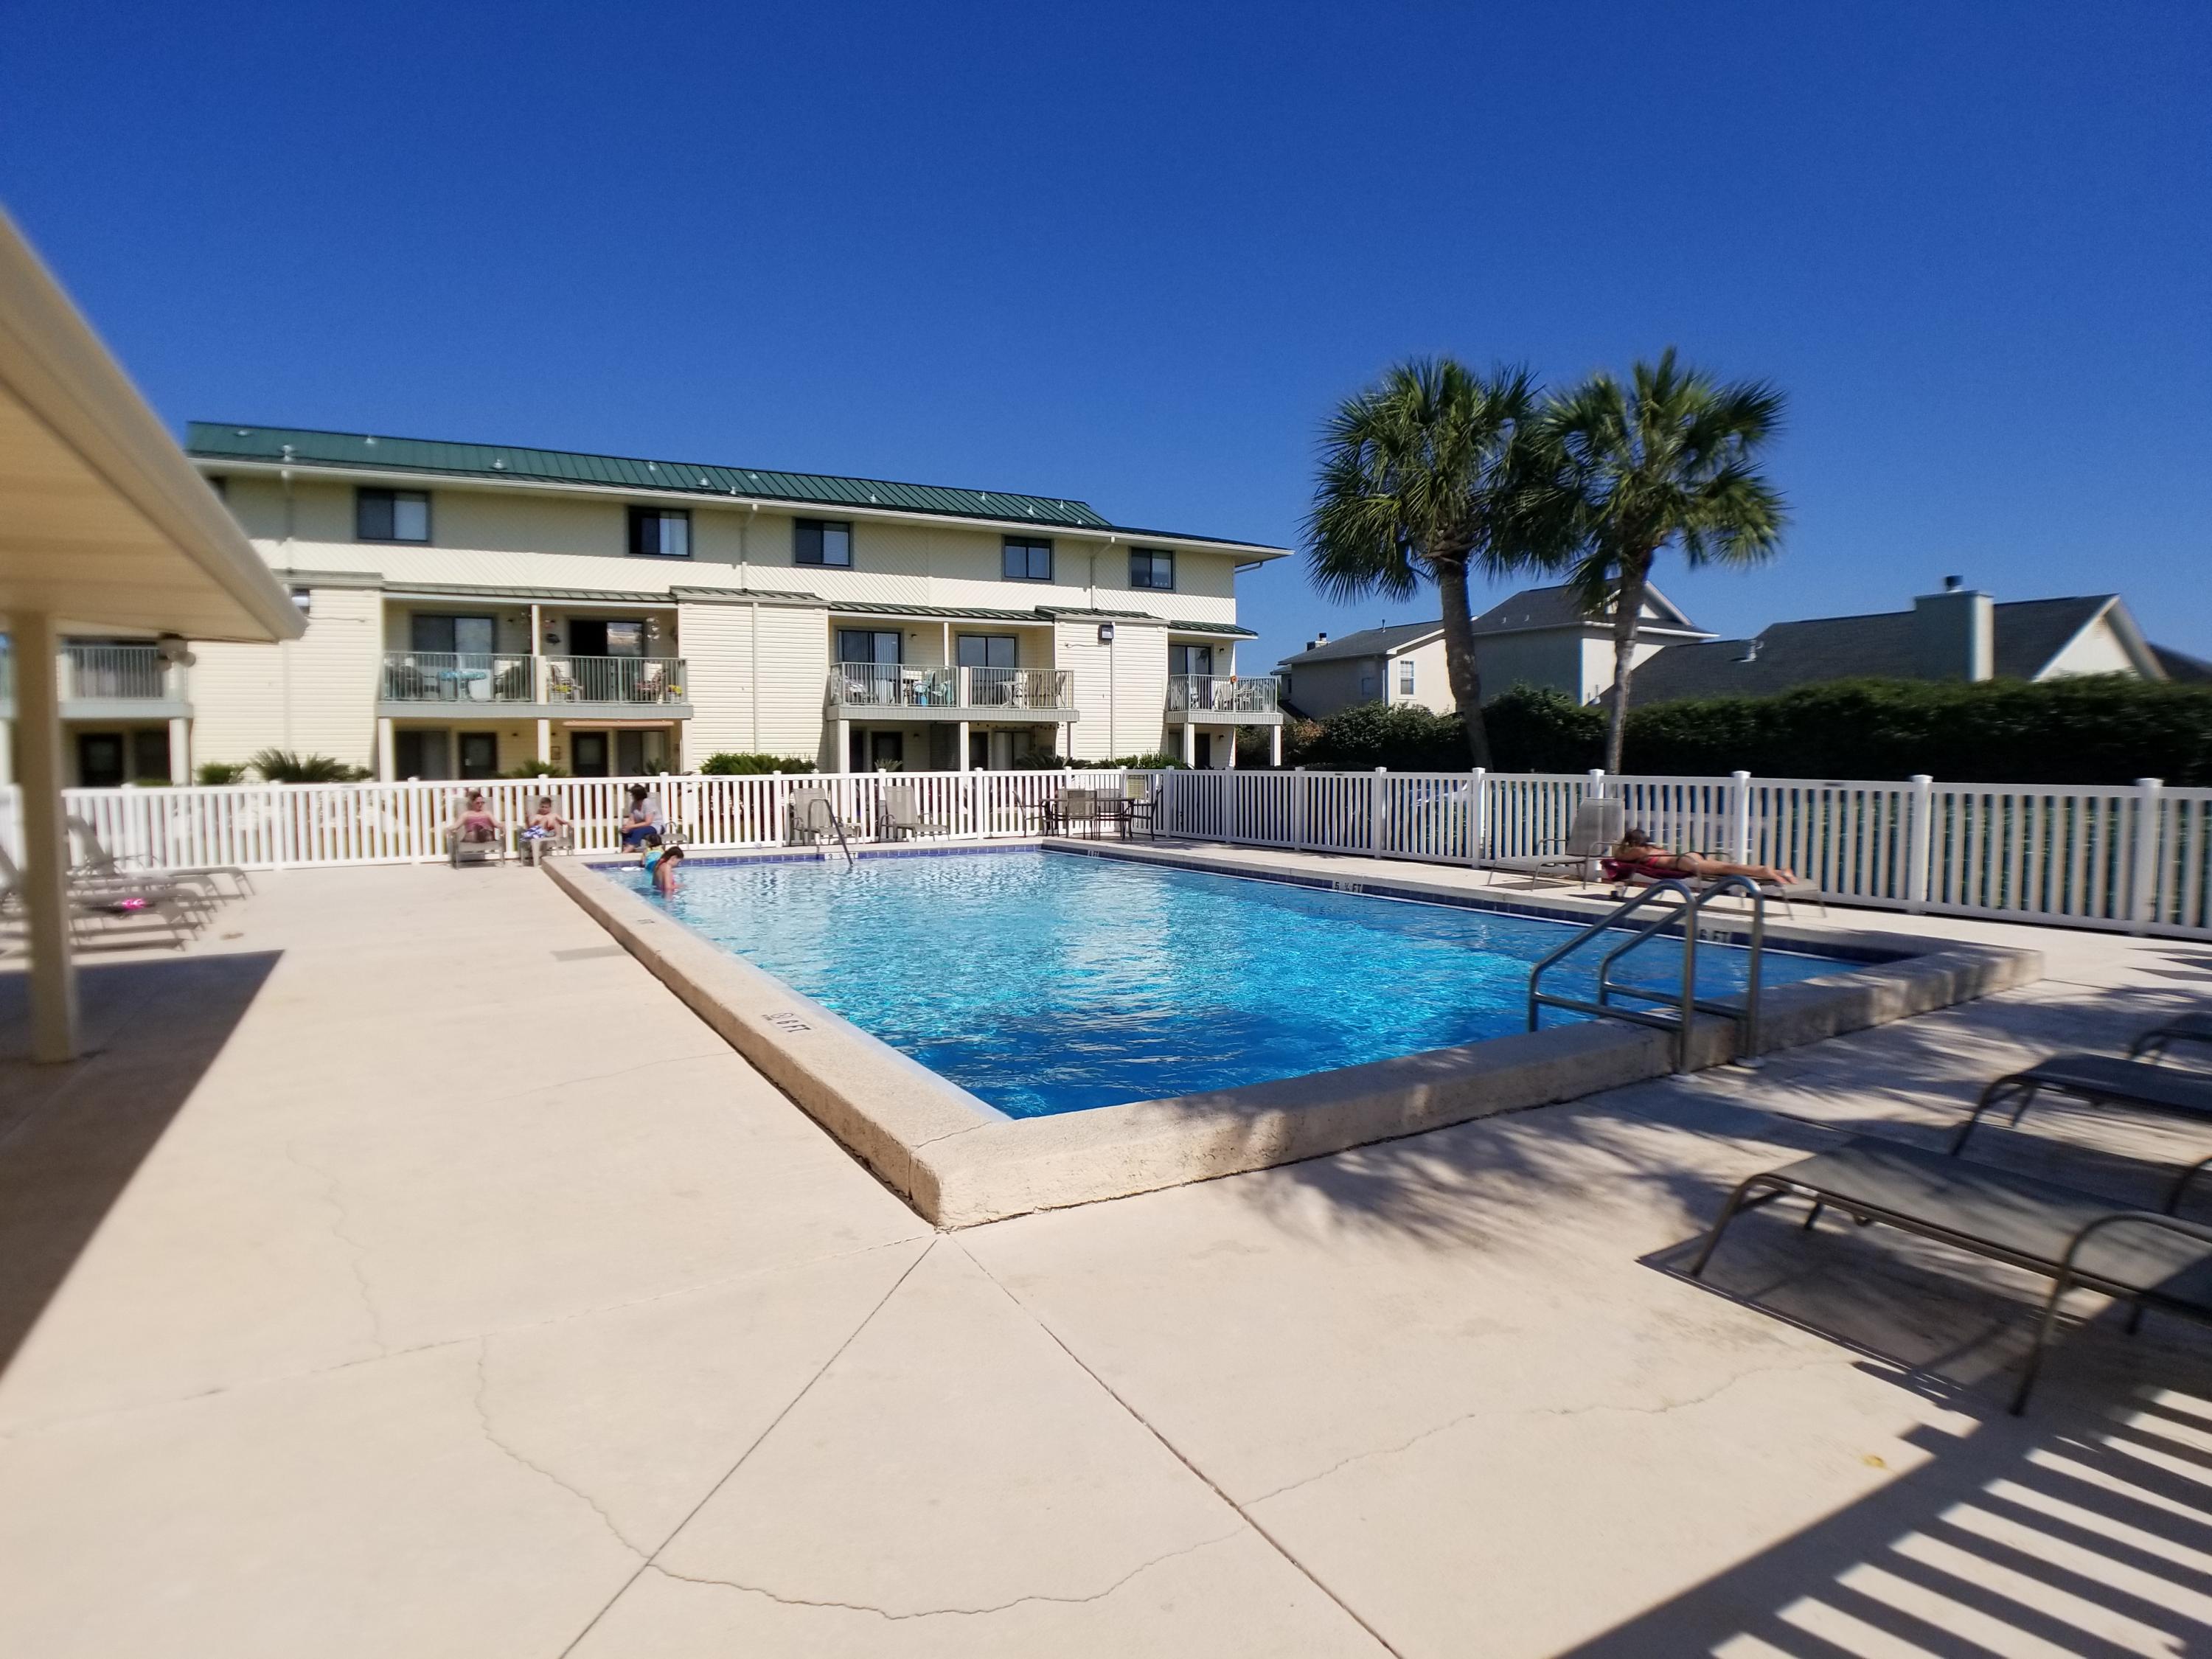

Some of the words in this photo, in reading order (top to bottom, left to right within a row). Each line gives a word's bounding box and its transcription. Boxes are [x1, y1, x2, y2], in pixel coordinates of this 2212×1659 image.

[1335, 881, 1340, 891] 5
[1352, 883, 1362, 893] FT
[1713, 930, 1729, 943] FT
[782, 1023, 811, 1032] FT
